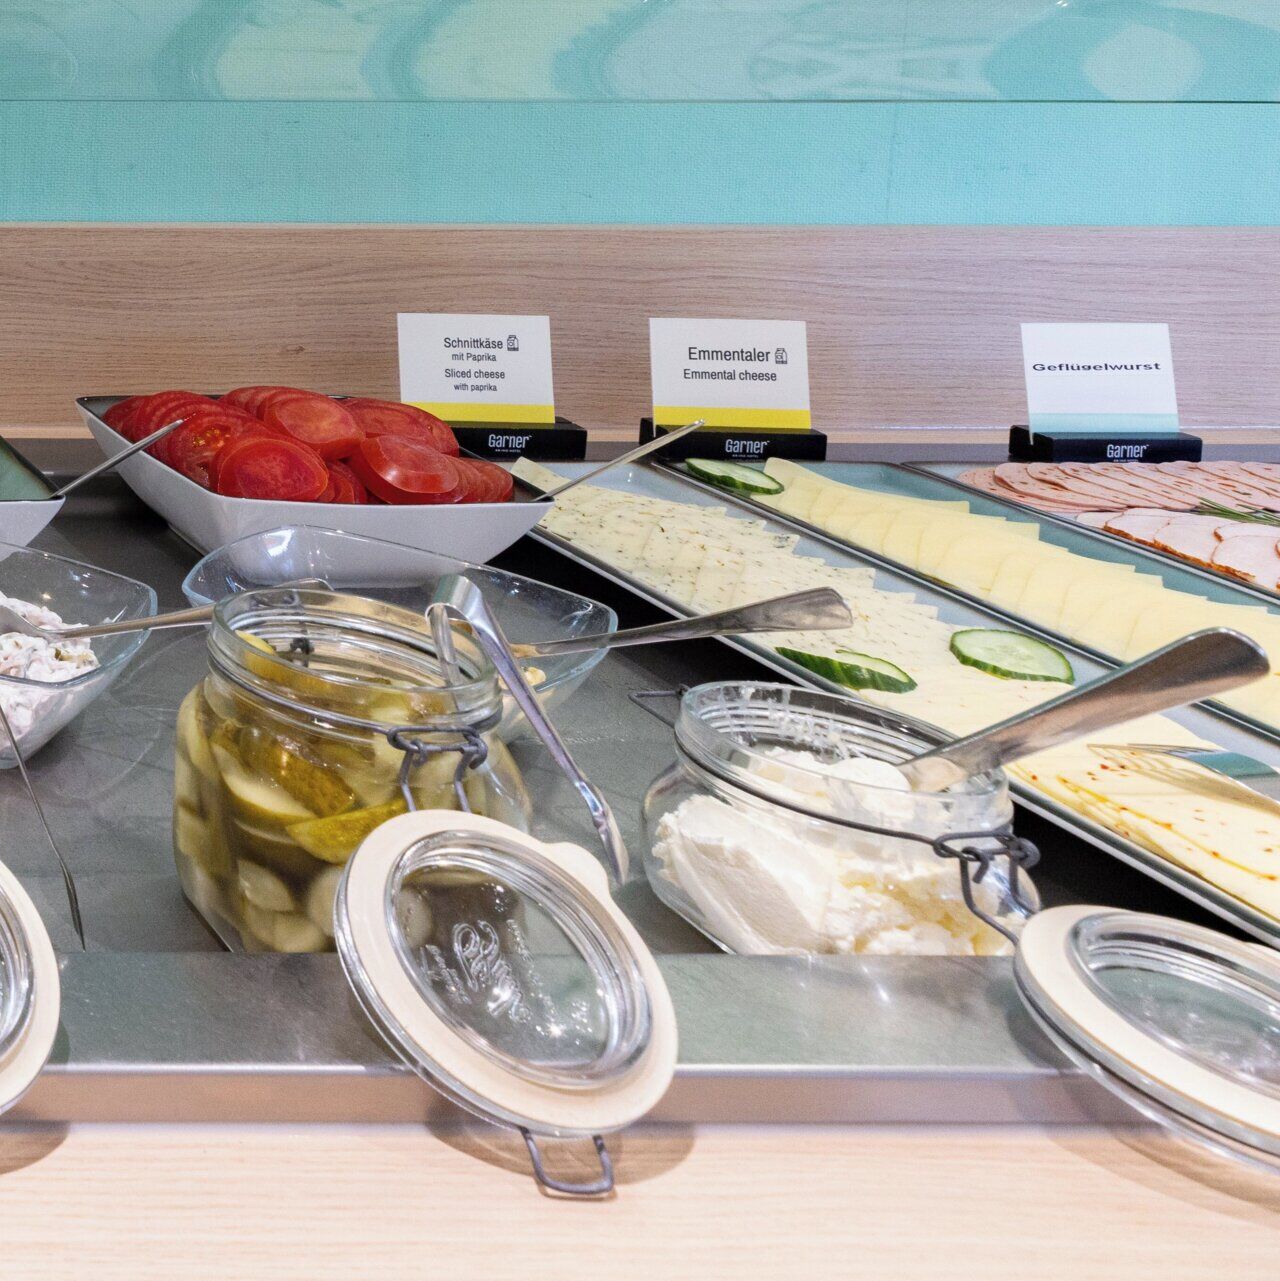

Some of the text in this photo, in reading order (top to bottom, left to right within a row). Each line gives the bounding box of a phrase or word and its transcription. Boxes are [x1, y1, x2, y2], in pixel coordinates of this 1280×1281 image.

[443, 336, 504, 350] Schnittkäse
[451, 352, 497, 363] mit Paprika
[688, 346, 771, 362] Emmentaler
[444, 368, 506, 380] Sliced cheese
[1032, 362, 1162, 372] Geflügelwurst
[683, 368, 777, 382] Emmental cheese
[453, 382, 498, 393] with paprika
[488, 434, 530, 448] Garner
[725, 438, 768, 454] Garner
[1106, 443, 1146, 459] Garner
